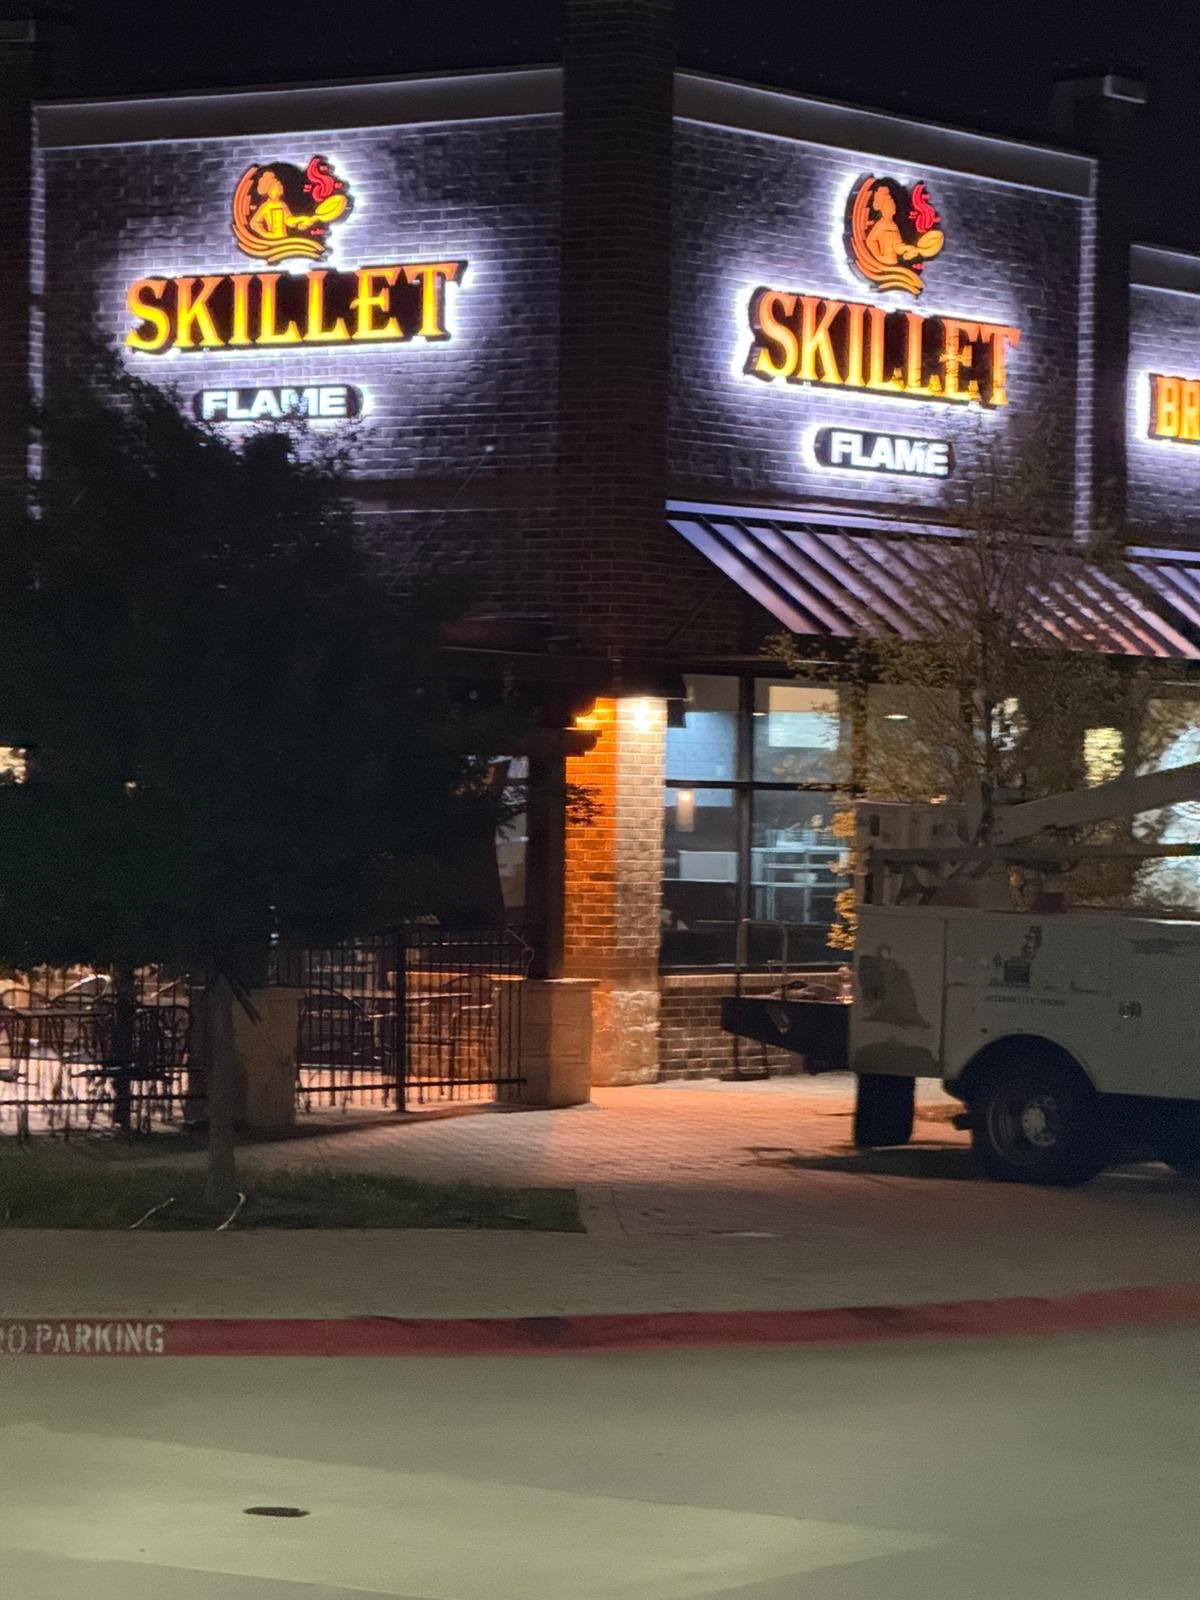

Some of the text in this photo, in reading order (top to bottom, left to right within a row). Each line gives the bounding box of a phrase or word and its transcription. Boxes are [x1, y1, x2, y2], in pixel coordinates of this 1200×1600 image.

[124, 260, 461, 353] SKILLET
[755, 289, 1023, 405] SKILLET
[202, 384, 349, 421] FLAME
[830, 431, 949, 476] FLAME
[0, 1322, 165, 1354] O PARKING
